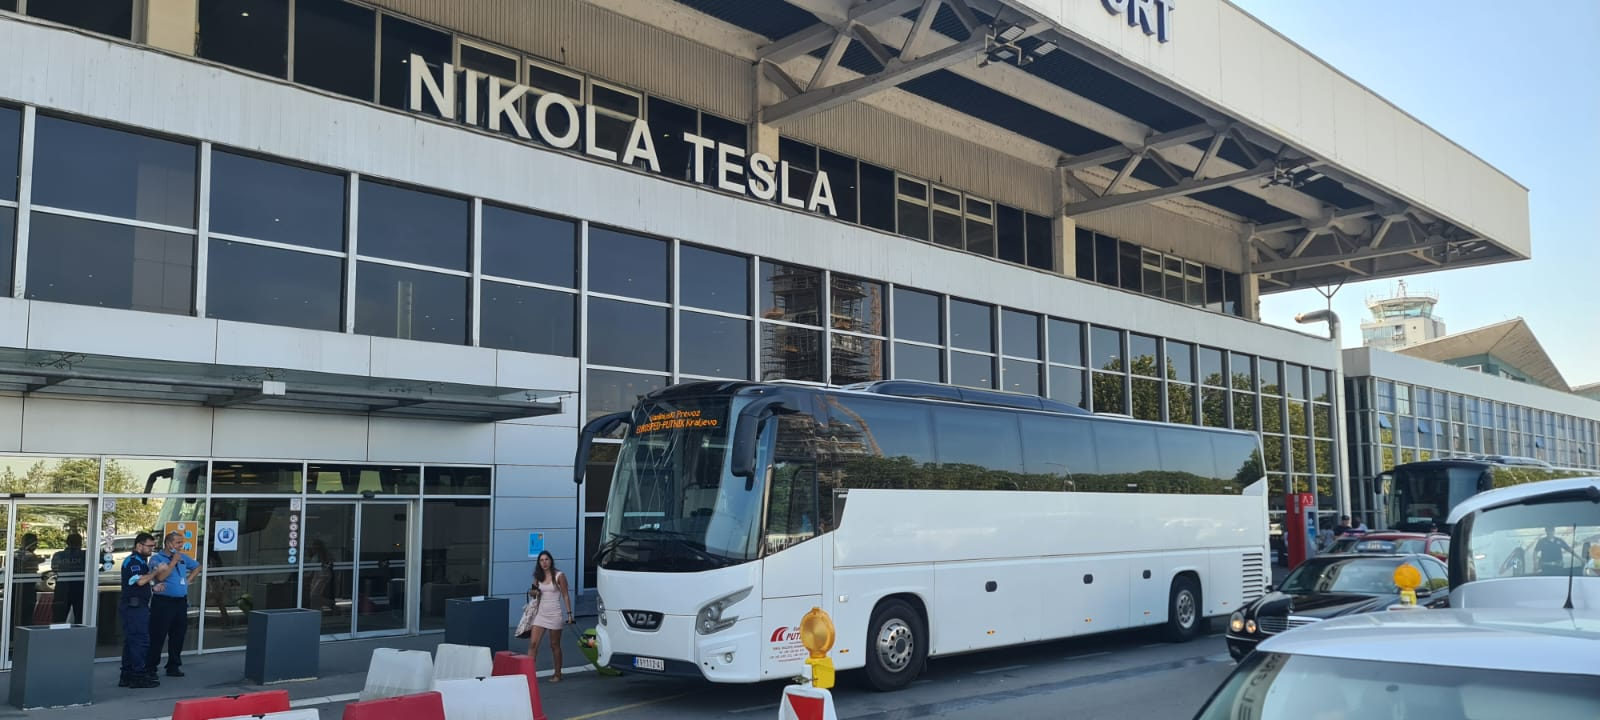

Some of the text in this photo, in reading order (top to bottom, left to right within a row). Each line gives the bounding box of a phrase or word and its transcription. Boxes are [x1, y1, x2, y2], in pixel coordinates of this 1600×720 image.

[408, 52, 838, 217] NIKOLA TESLA
[627, 612, 657, 625] VDL
